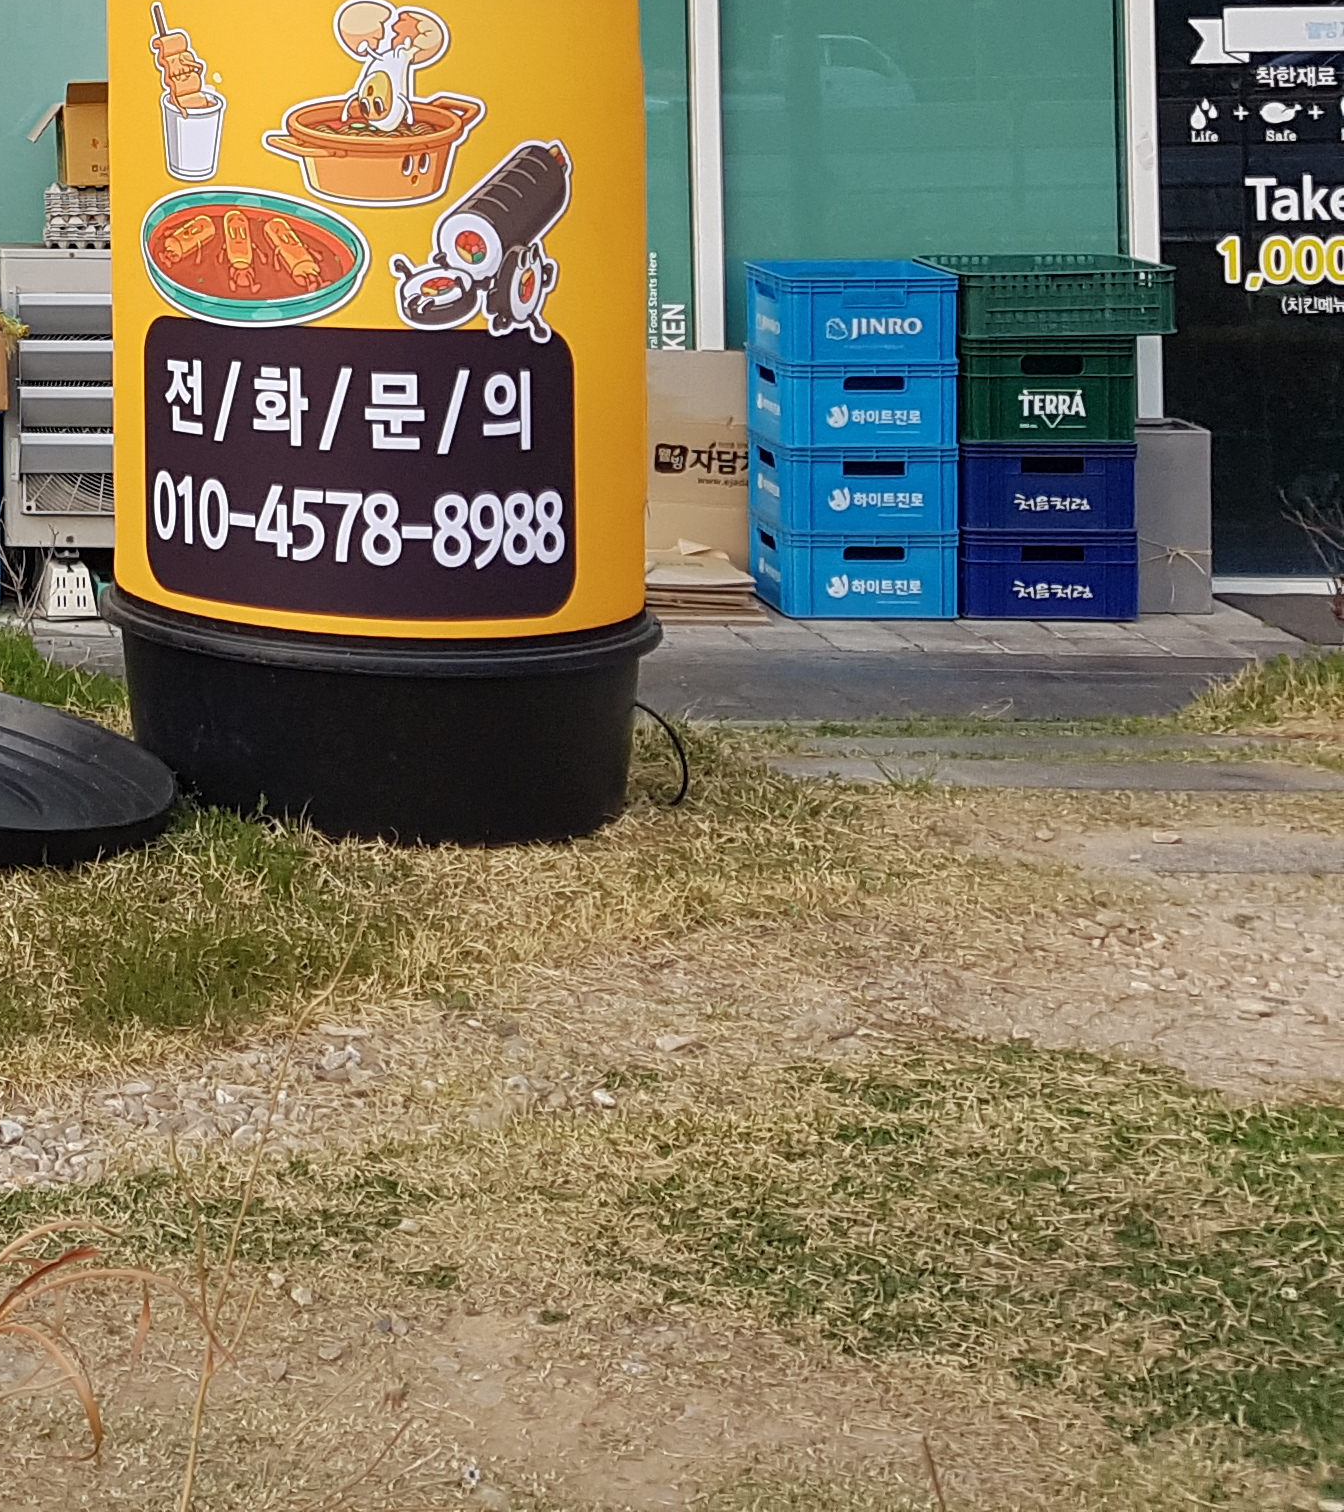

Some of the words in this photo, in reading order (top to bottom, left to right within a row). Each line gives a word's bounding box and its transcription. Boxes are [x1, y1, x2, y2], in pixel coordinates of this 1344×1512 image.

[1255, 66, 1338, 88] 착한재료
[1190, 130, 1220, 143] Life
[1265, 129, 1298, 142] Safe
[850, 316, 923, 339] JINRO
[851, 408, 922, 425] 하이트진로
[853, 491, 925, 508] 하이트진로
[153, 469, 566, 570] 010-4578-8988
[851, 579, 922, 596] 하이트진로
